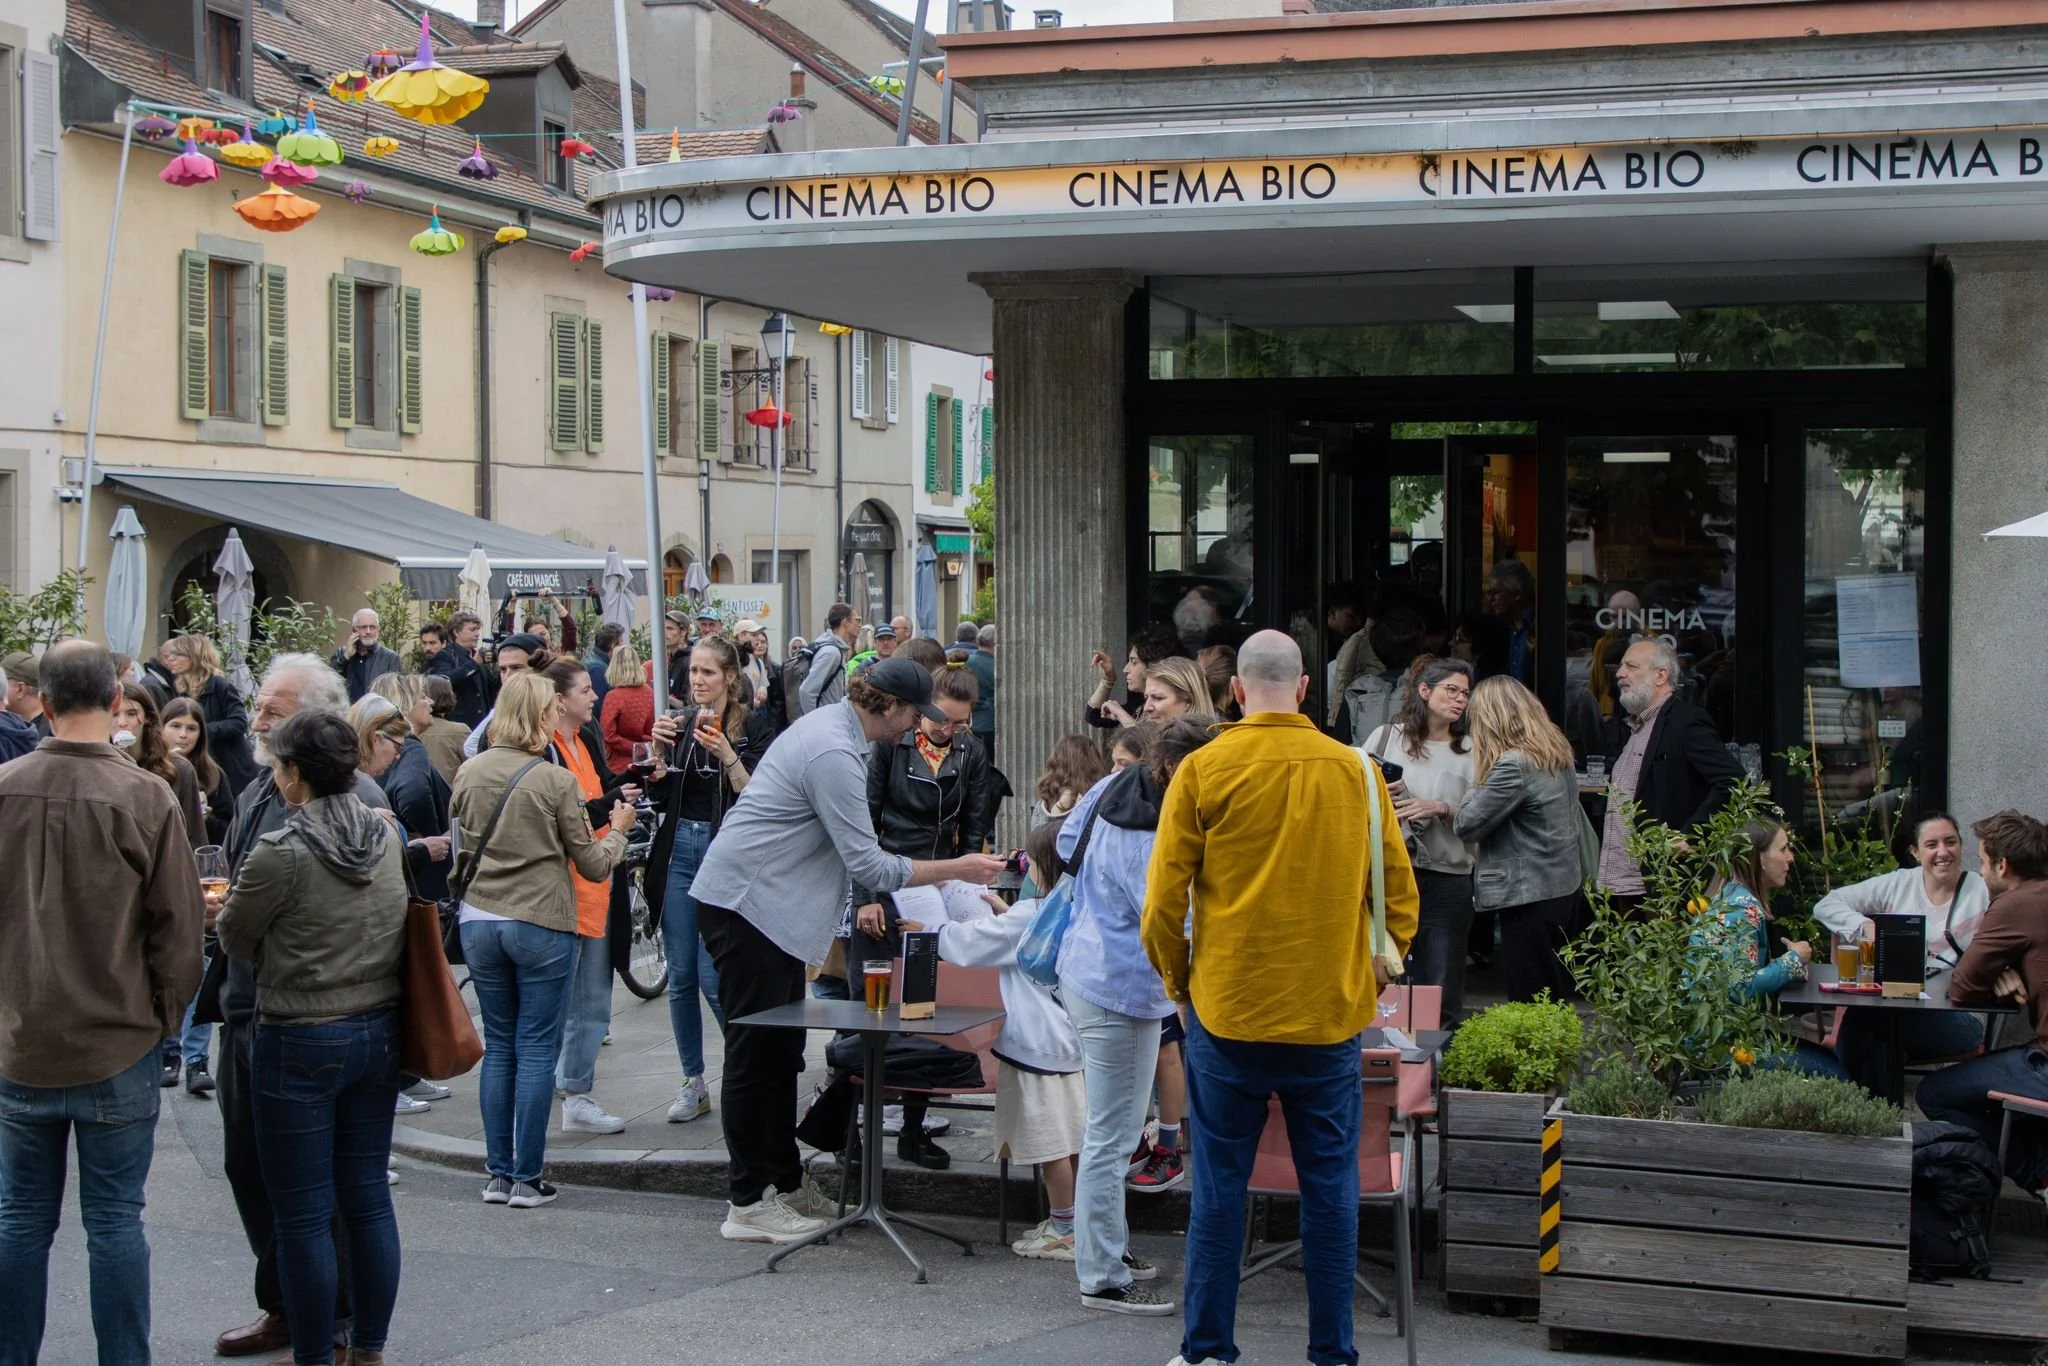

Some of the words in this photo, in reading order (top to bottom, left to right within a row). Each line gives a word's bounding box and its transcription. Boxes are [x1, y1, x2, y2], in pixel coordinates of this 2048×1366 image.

[1419, 153, 1607, 197] CINEMA
[1625, 149, 1705, 189] BIO
[1797, 138, 1999, 183] CINEMA
[746, 178, 909, 221] CINEMA
[925, 176, 995, 213] BIO
[1069, 165, 1245, 208] CINEMA
[1262, 162, 1336, 200] BIO
[636, 193, 685, 232] BIO
[507, 570, 524, 587] CAFÉ
[524, 574, 534, 587] DU
[534, 570, 560, 587] MARCHÉ
[1595, 608, 1707, 630] CINEMA
